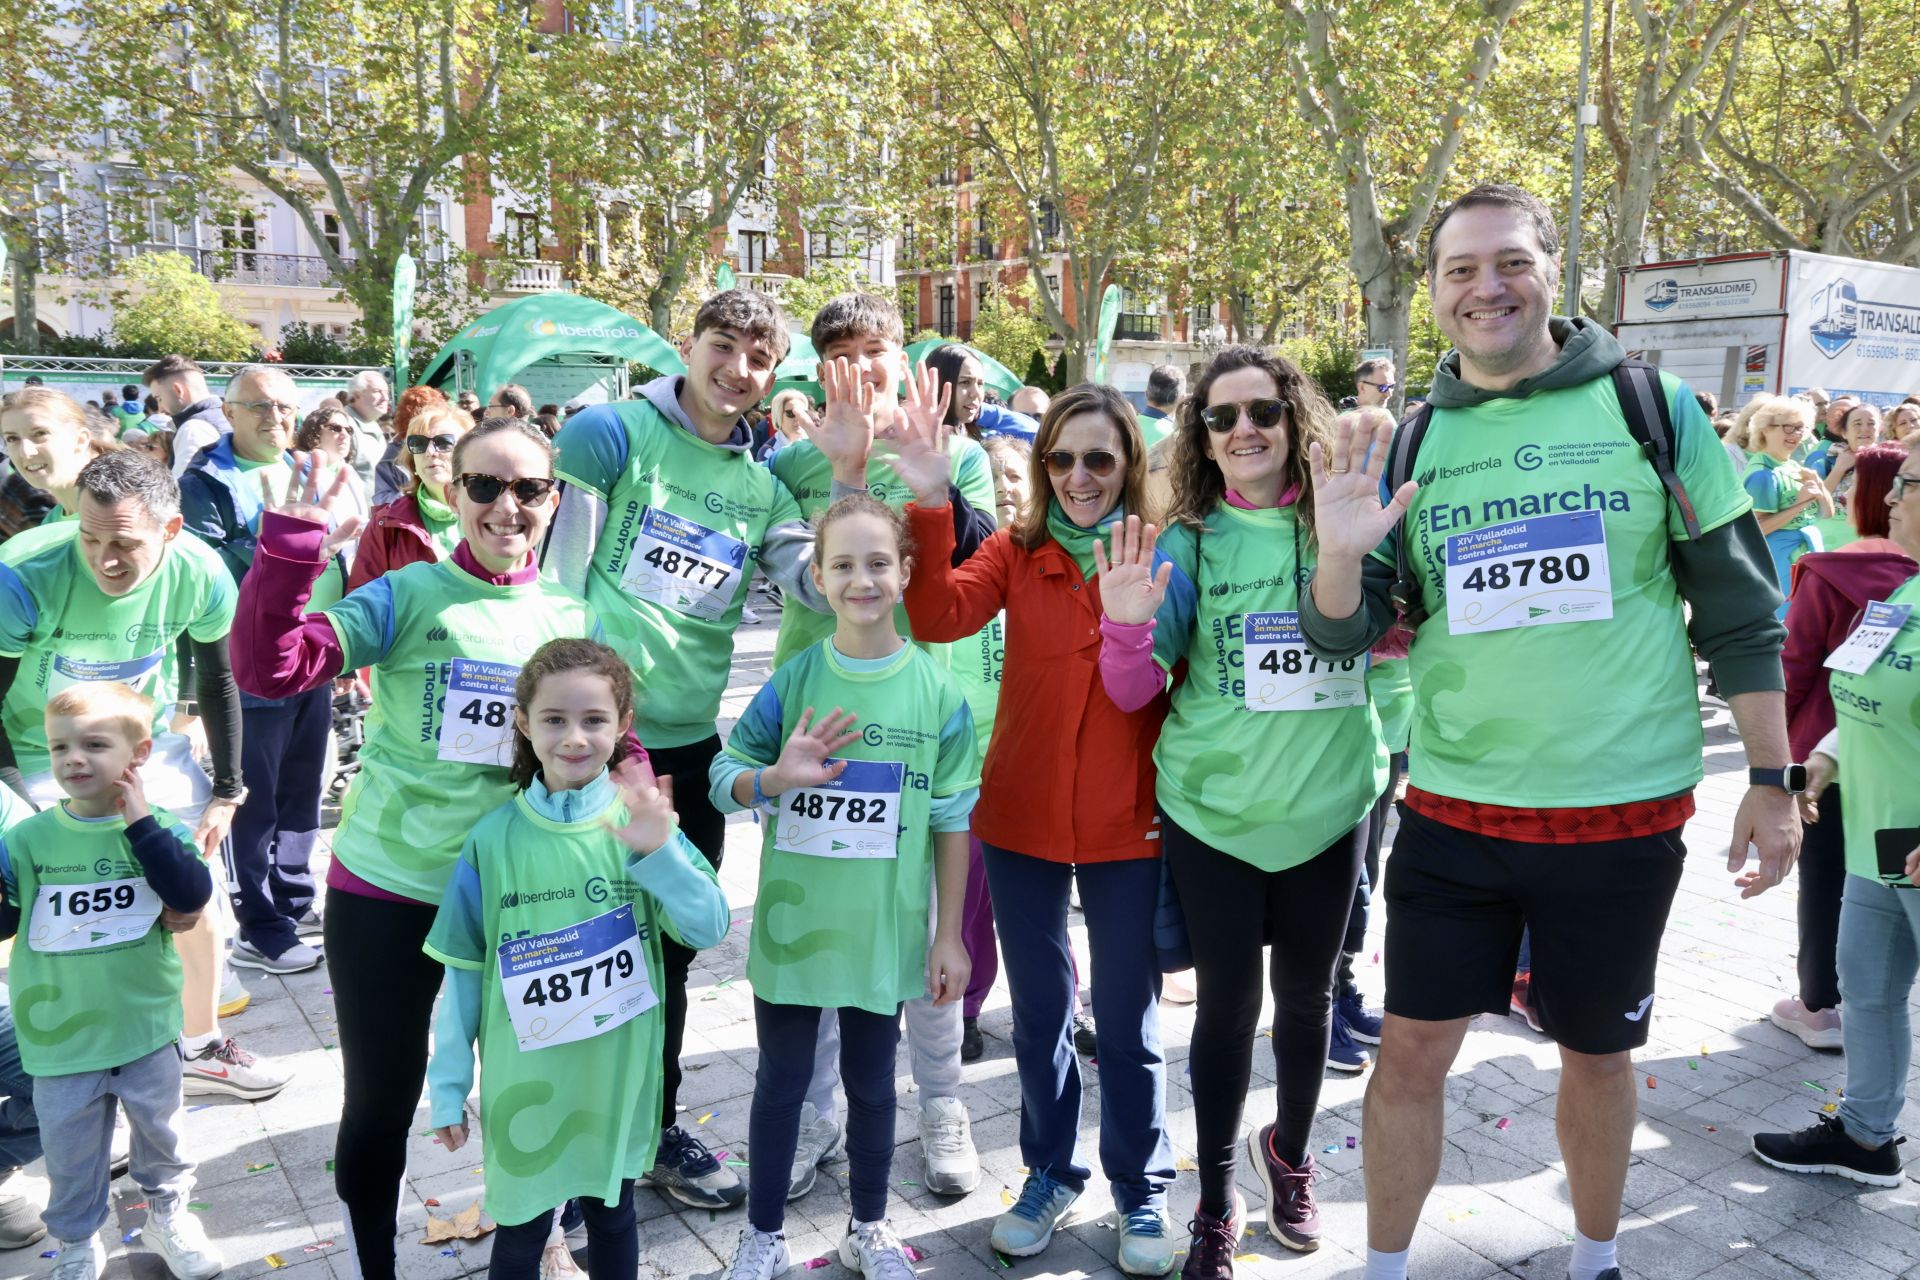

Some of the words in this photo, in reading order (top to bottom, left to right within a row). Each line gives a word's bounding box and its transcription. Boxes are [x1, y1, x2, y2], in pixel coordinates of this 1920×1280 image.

[1680, 282, 1751, 298] TRANSALDIME
[558, 321, 640, 339] Iberdrola
[1548, 442, 1591, 451] asociación
[1593, 440, 1631, 448] española
[1548, 451, 1575, 459] contra
[1576, 449, 1584, 457] el
[1585, 448, 1614, 457] cáncer
[1439, 457, 1502, 480] Iberdrola
[1560, 457, 1600, 466] Valladolid
[1430, 503, 1472, 533] En
[1482, 483, 1631, 522] marcha
[656, 513, 669, 523] XIV
[670, 518, 707, 538] Valladolid
[662, 524, 688, 538] marcha
[607, 500, 638, 574] VALLADOLID
[650, 528, 672, 540] contra
[672, 535, 680, 543] el
[680, 539, 702, 550] cáncer
[1457, 535, 1474, 547] XIV
[1475, 524, 1527, 542] Valladolid
[1419, 508, 1444, 599] VALLADOLID
[1457, 550, 1486, 561] contra
[1486, 546, 1496, 554] el
[1497, 542, 1529, 552] cáncer
[1469, 539, 1503, 551] marcha
[644, 546, 730, 590] 48777
[1462, 553, 1591, 593] 48780
[1231, 576, 1284, 594] Iberdrola
[1254, 617, 1270, 625] XIV
[1266, 624, 1297, 632] marcha
[64, 630, 118, 642] Iberdrola
[1254, 632, 1281, 640] contra
[1281, 631, 1291, 639] el
[1213, 617, 1229, 697] VALLADOLID
[462, 663, 480, 673] XIV
[460, 680, 488, 690] contra
[489, 683, 499, 691] el
[499, 685, 517, 693] cán
[474, 674, 507, 684] marcha
[421, 661, 436, 743] VALLADOLID
[790, 792, 887, 824] 48782
[44, 863, 87, 874] Iberdrola
[48, 885, 135, 917] 1659
[520, 887, 576, 905] Iberdrola
[508, 941, 527, 955] XIV
[528, 930, 580, 949] Valladolid
[511, 954, 523, 962] en
[524, 945, 559, 959] marcha
[512, 959, 543, 971] contra
[543, 954, 553, 964] el
[554, 949, 584, 962] cáncer
[522, 949, 634, 1007] 48779
